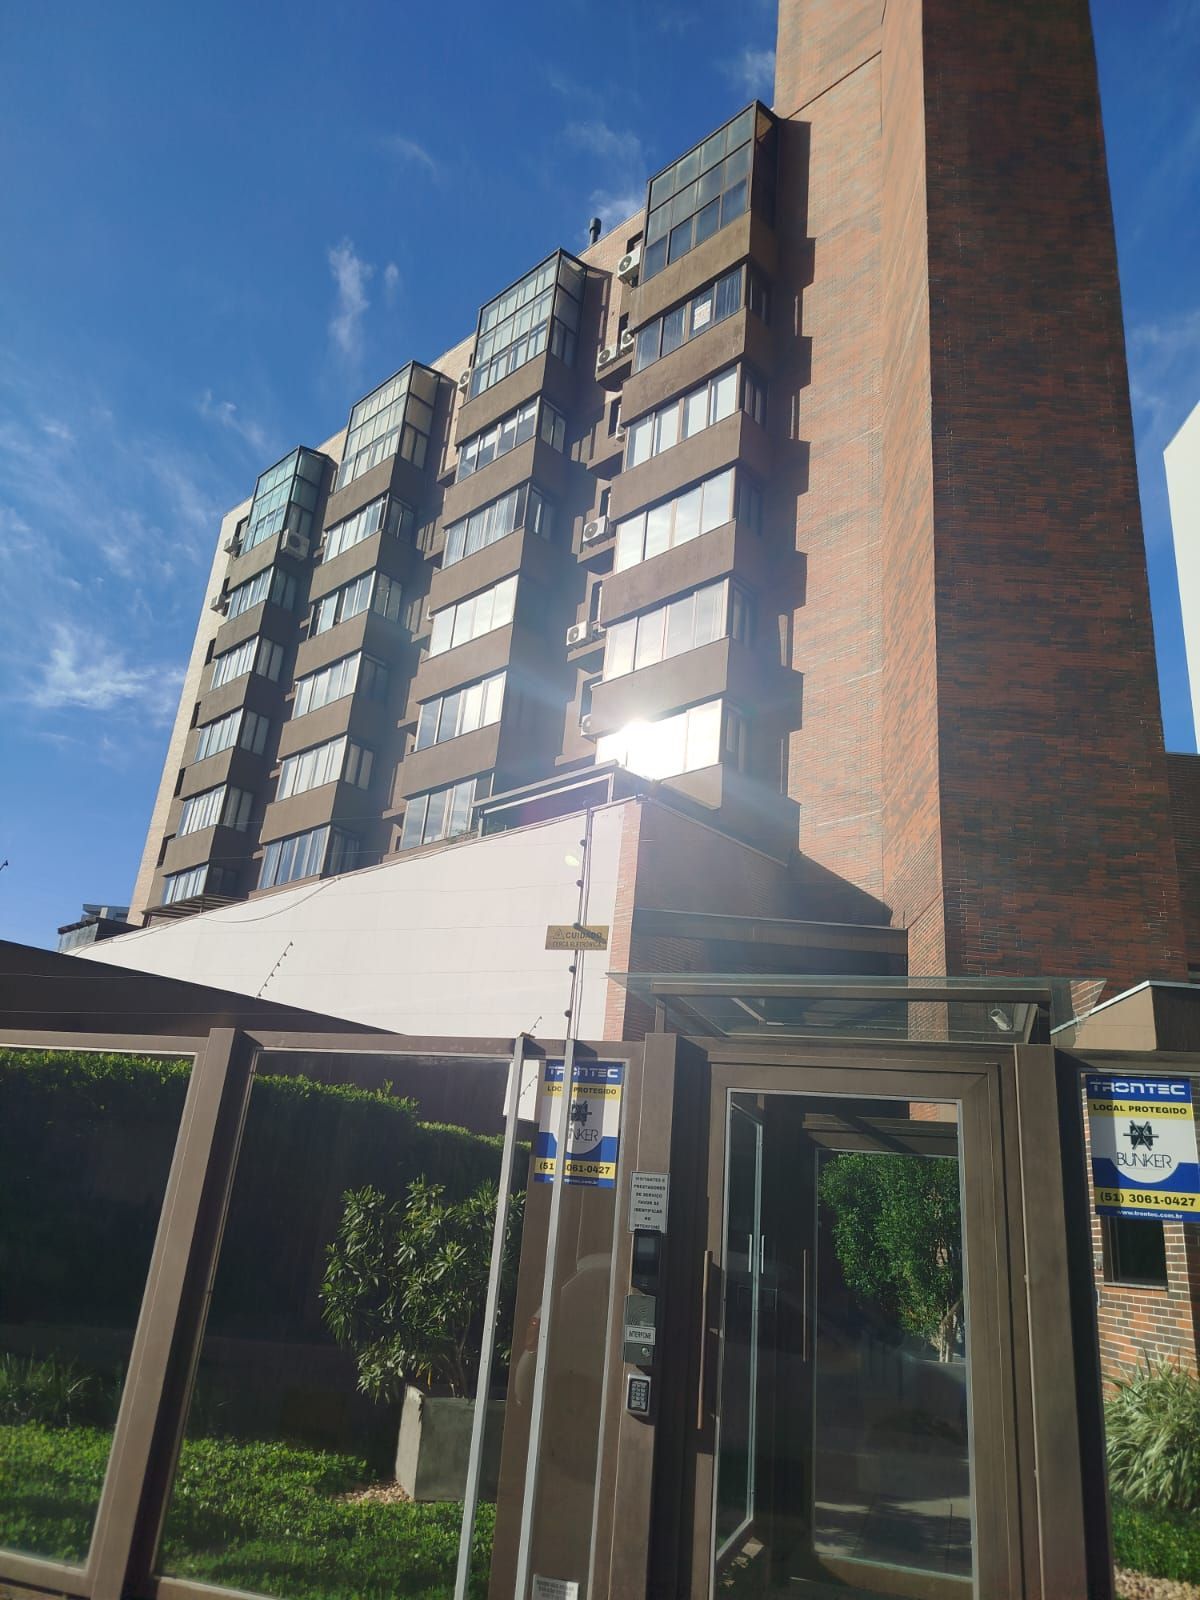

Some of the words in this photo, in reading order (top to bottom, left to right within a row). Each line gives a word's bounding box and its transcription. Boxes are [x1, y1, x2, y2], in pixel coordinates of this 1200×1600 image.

[573, 1086, 617, 1095] PROTEGIDO
[1090, 1081, 1186, 1095] TRONTEC
[1093, 1104, 1126, 1112] LOCAL
[1128, 1105, 1187, 1115] PROTEGIDO
[572, 1127, 599, 1141] NKER
[1116, 1152, 1172, 1168] BUNKER
[539, 1162, 554, 1170] (51
[566, 1163, 612, 1175] 061-0427
[1100, 1192, 1125, 1203] (51)
[1129, 1194, 1196, 1207] 3061-0427
